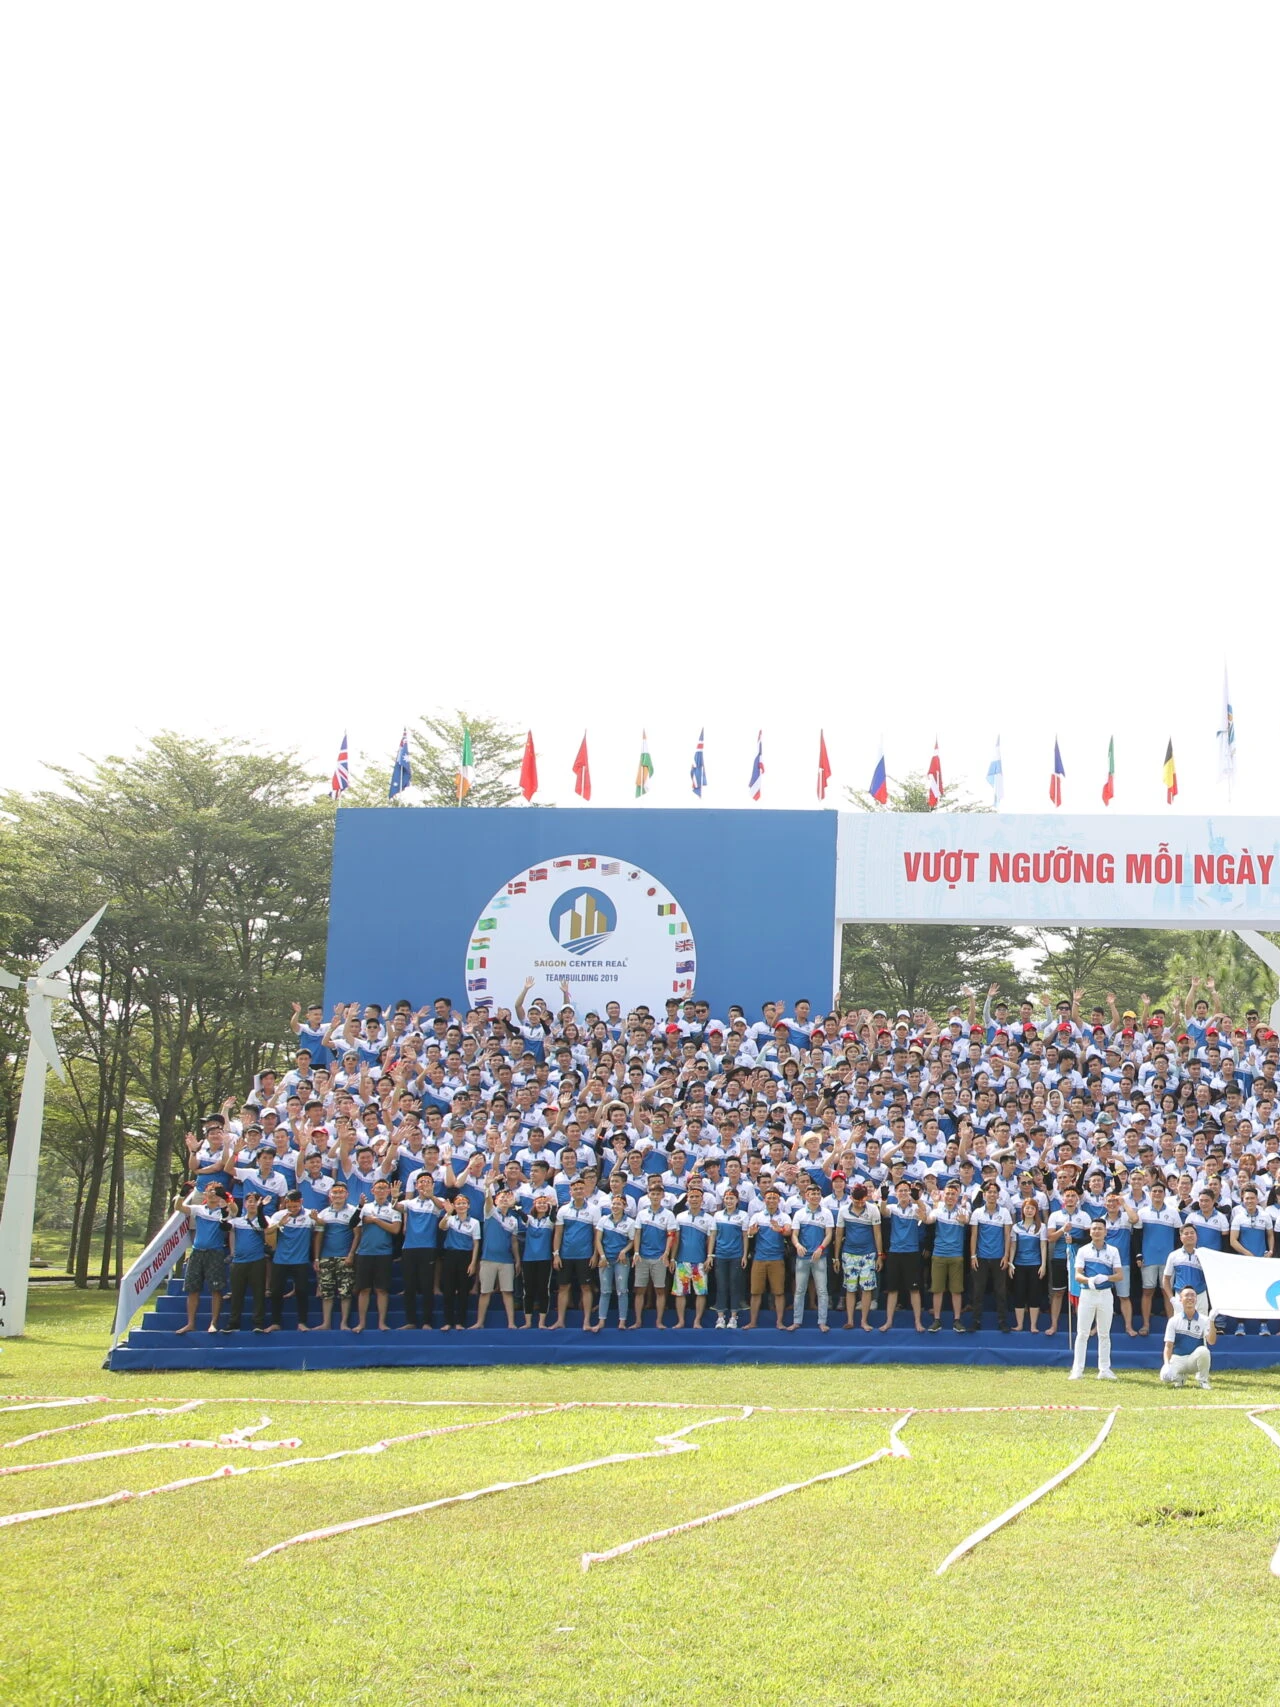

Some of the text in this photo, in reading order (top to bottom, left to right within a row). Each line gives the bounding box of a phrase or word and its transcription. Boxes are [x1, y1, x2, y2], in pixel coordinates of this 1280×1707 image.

[903, 849, 979, 889] VƯỢT
[989, 845, 1115, 884] NGƯỠNG
[1126, 843, 1183, 885] MỖI
[1194, 847, 1275, 885] NGÀY
[534, 960, 628, 968] SAIGON CENTER REAL
[546, 974, 619, 982] TEAMBUILDING 2019
